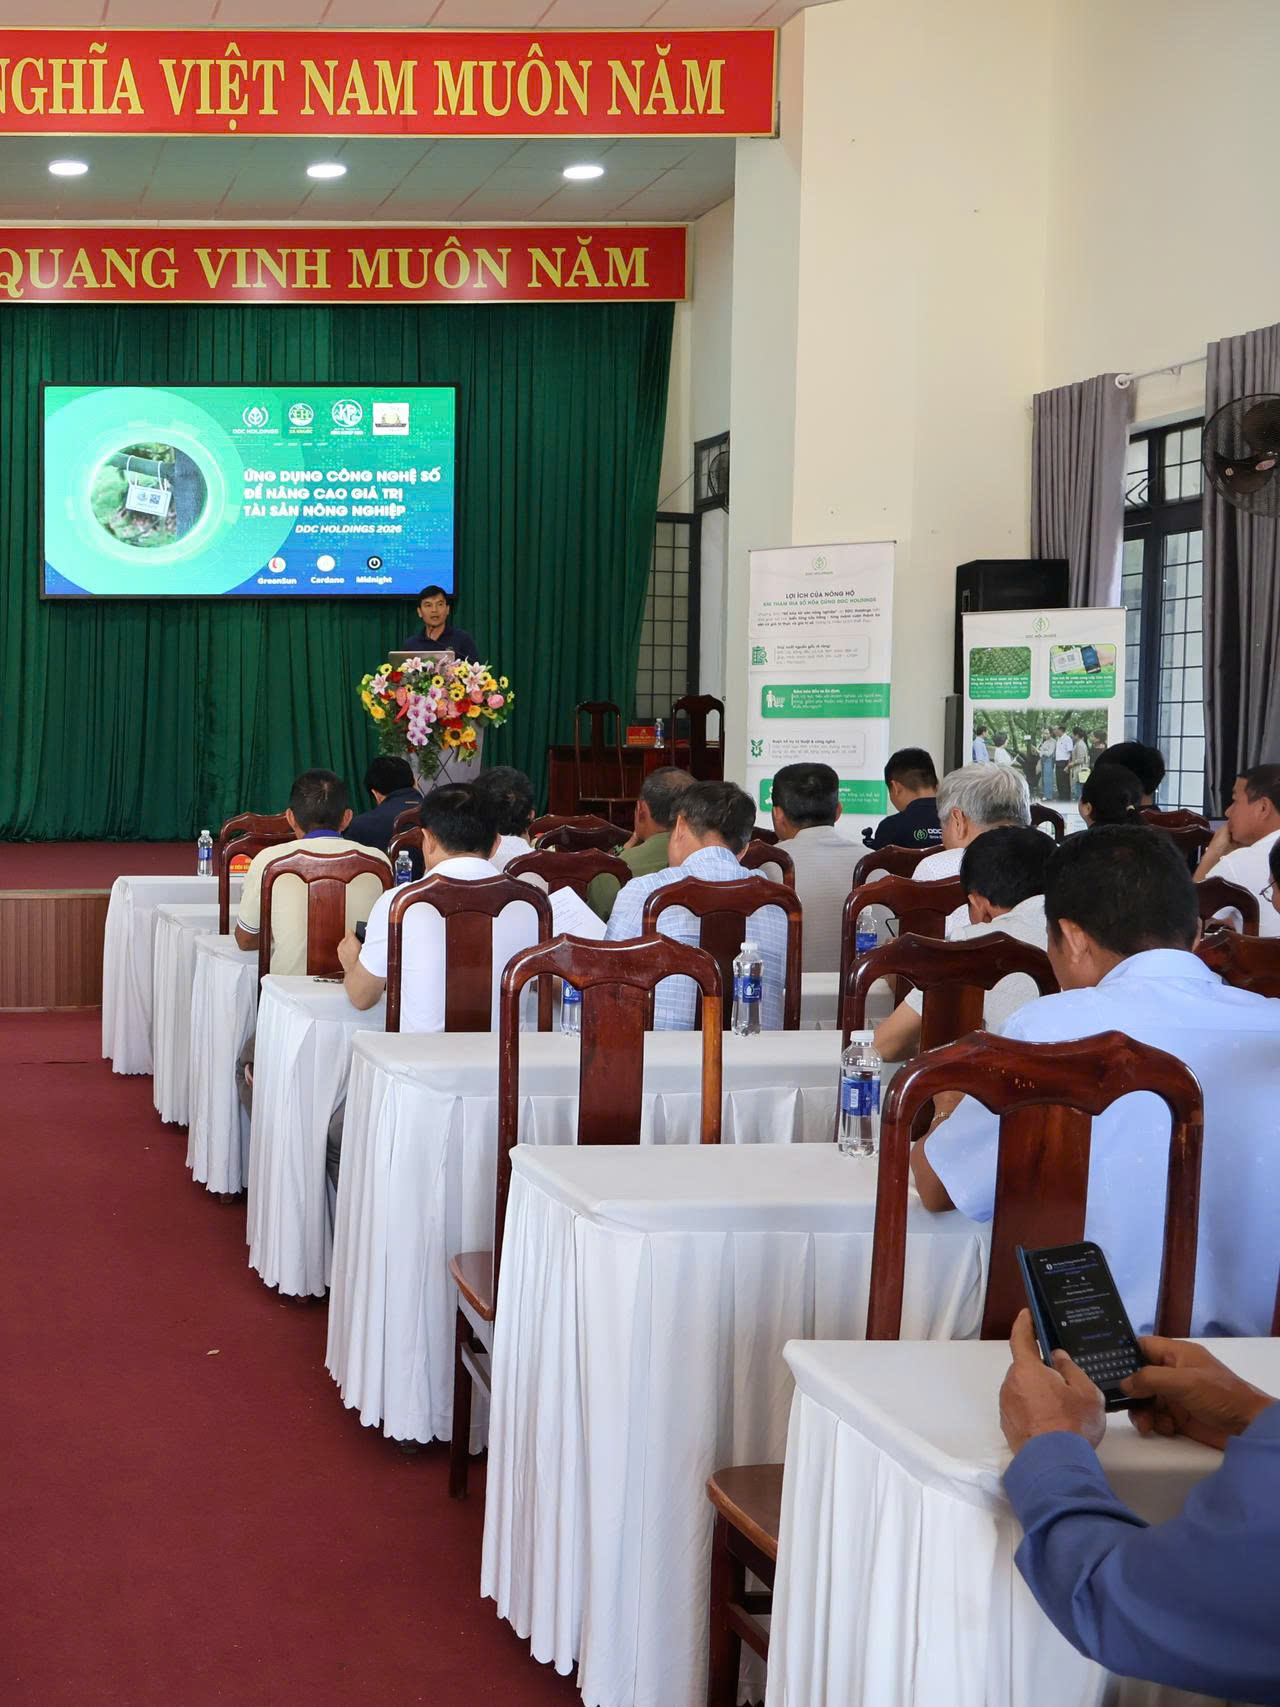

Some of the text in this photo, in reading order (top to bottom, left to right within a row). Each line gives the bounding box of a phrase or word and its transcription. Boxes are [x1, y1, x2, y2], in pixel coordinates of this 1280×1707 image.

[158, 42, 286, 130] VIỆT
[300, 58, 418, 116] NAM
[433, 42, 593, 117] MUÔN
[607, 43, 726, 116] NĂM
[194, 247, 331, 289] VINH
[348, 236, 511, 289] MUÔN
[526, 237, 650, 288] NĂM
[244, 466, 441, 485] ỨNG DỤNG CÔNG NGHỆ SỐ
[244, 484, 404, 502] ĐỂ NÂNG CAO GIÁ TRỊ
[244, 502, 406, 519] TÀI SẢN NÔNG NGHIỆP
[295, 525, 319, 534] DDC
[320, 525, 375, 534] HOLDINGS
[257, 577, 297, 585] GreenSun
[310, 576, 345, 584] Cardano
[355, 576, 393, 586] Midnight
[810, 590, 823, 598] CỦA
[845, 589, 856, 597] HỘ
